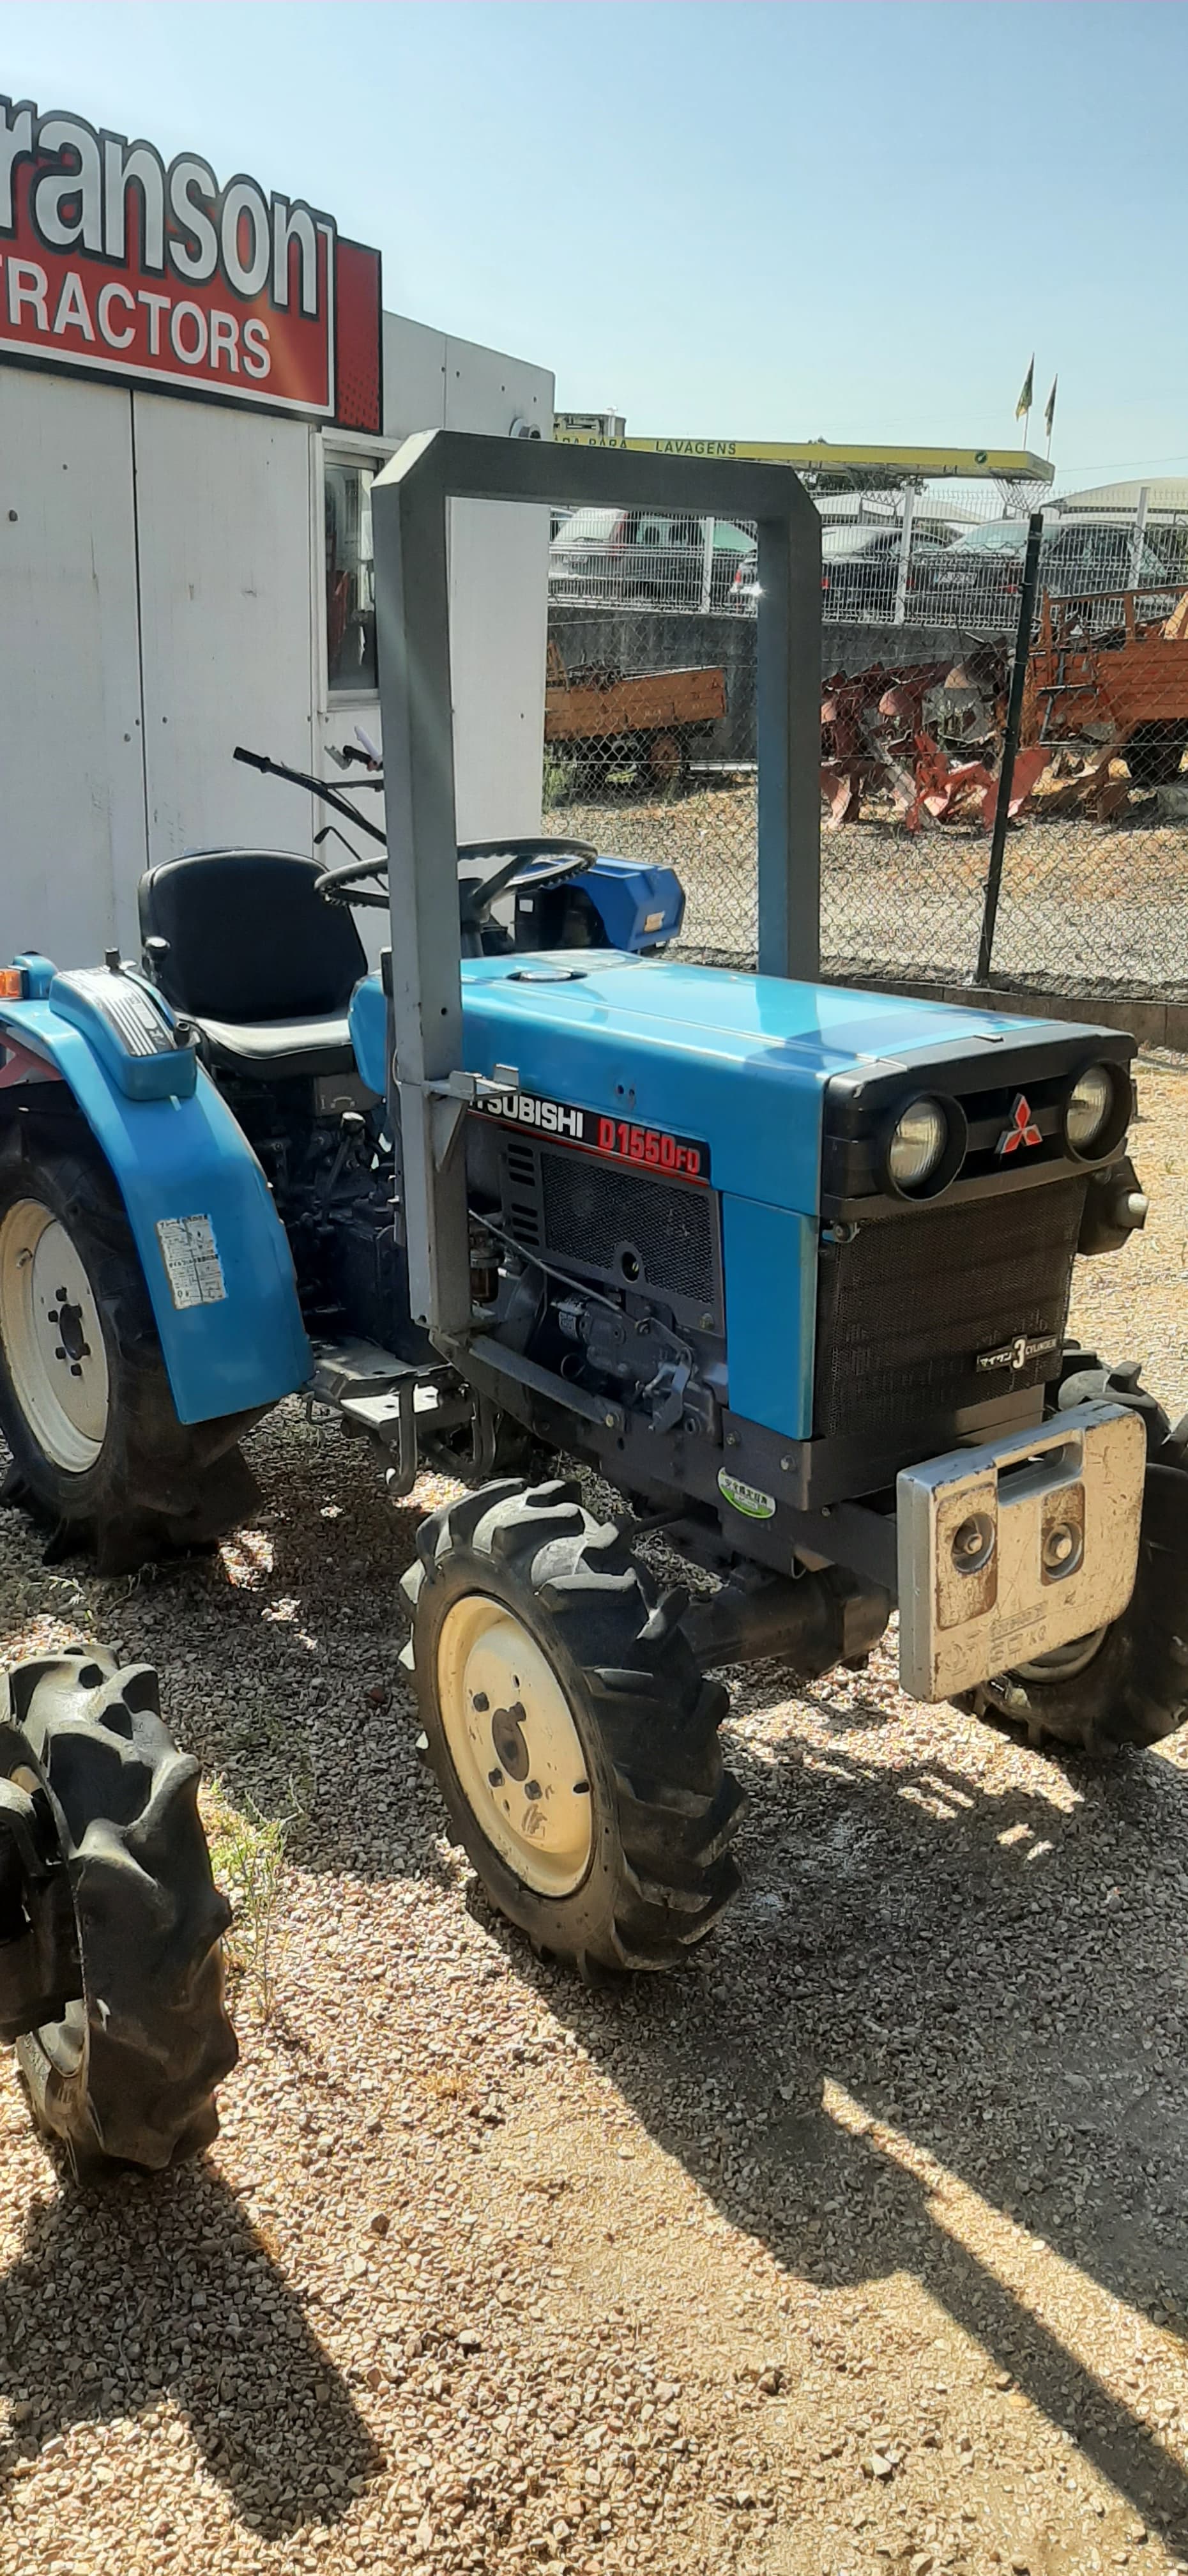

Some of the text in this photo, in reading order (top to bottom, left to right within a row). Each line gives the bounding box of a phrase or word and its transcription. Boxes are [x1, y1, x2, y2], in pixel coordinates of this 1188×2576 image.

[0, 255, 271, 379] RACTORS
[655, 440, 736, 454] LAVAGENS
[469, 1095, 583, 1138] SUBISHI
[1012, 1338, 1026, 1368] 3
